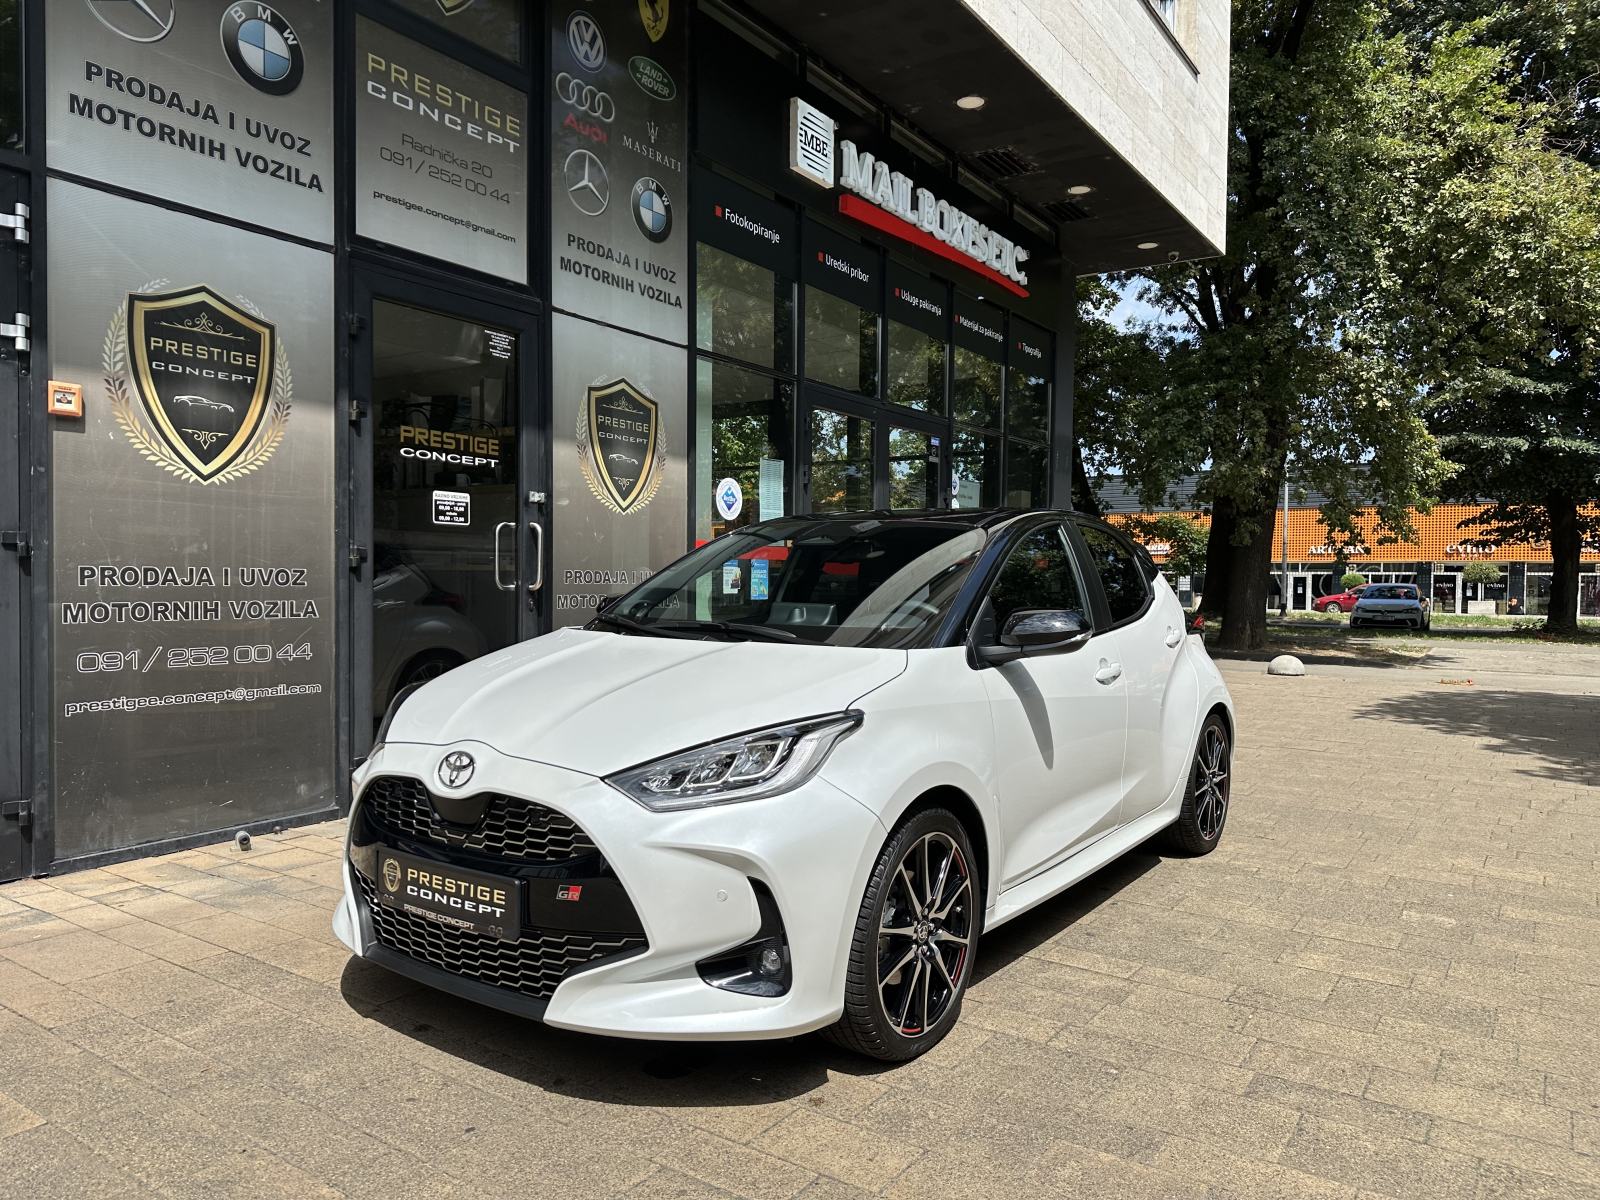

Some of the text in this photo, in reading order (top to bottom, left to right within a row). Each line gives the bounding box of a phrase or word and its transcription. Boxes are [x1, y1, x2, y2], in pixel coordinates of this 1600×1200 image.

[640, 62, 662, 81] LAND
[641, 75, 669, 97] ROVER
[84, 60, 312, 157] PRODAJA I UVOZ
[367, 52, 520, 137] PRESTIGE
[367, 80, 520, 153] CONCEPT
[563, 112, 608, 144] Audi
[68, 92, 324, 193] MOTORNIH VOZILA
[401, 132, 493, 179] Radnička 20
[622, 135, 681, 172] MASERATI
[803, 128, 828, 158] MBE
[428, 164, 462, 188] 252
[465, 178, 487, 197] 00
[489, 188, 511, 204] 44
[373, 190, 516, 243] prestigee.concept@gmail.com
[840, 139, 919, 226] MAIL
[916, 187, 989, 263] BOXES
[725, 207, 780, 244] Fotokopiranje
[567, 232, 677, 284] PRODAJA I UVOZ
[825, 253, 869, 283] Uredski pribor
[560, 256, 683, 309] MOTORNIH VOZILA
[901, 289, 942, 316] Usluge pakiranja
[150, 336, 257, 368] PRESTIGE
[151, 361, 256, 384] CONCEPT
[597, 414, 650, 433] PRESTIGE
[598, 431, 649, 446] CONCEPT
[399, 425, 500, 456] PRESTIGE
[399, 447, 500, 468] CONCEPT
[77, 564, 308, 588] PRODAJA I UVOZ
[564, 569, 629, 585] PRODAJA
[632, 570, 636, 584] I
[61, 599, 320, 625] MOTORNIH VOZILA
[167, 646, 229, 668] 252
[233, 644, 272, 664] 00
[276, 642, 313, 662] 44
[64, 682, 322, 717] prestigee.concept@gmail.com
[406, 868, 506, 905] PRESTIGE
[406, 885, 505, 918] CONCEPT
[403, 903, 475, 930] PRESTIGE CONCEPT
